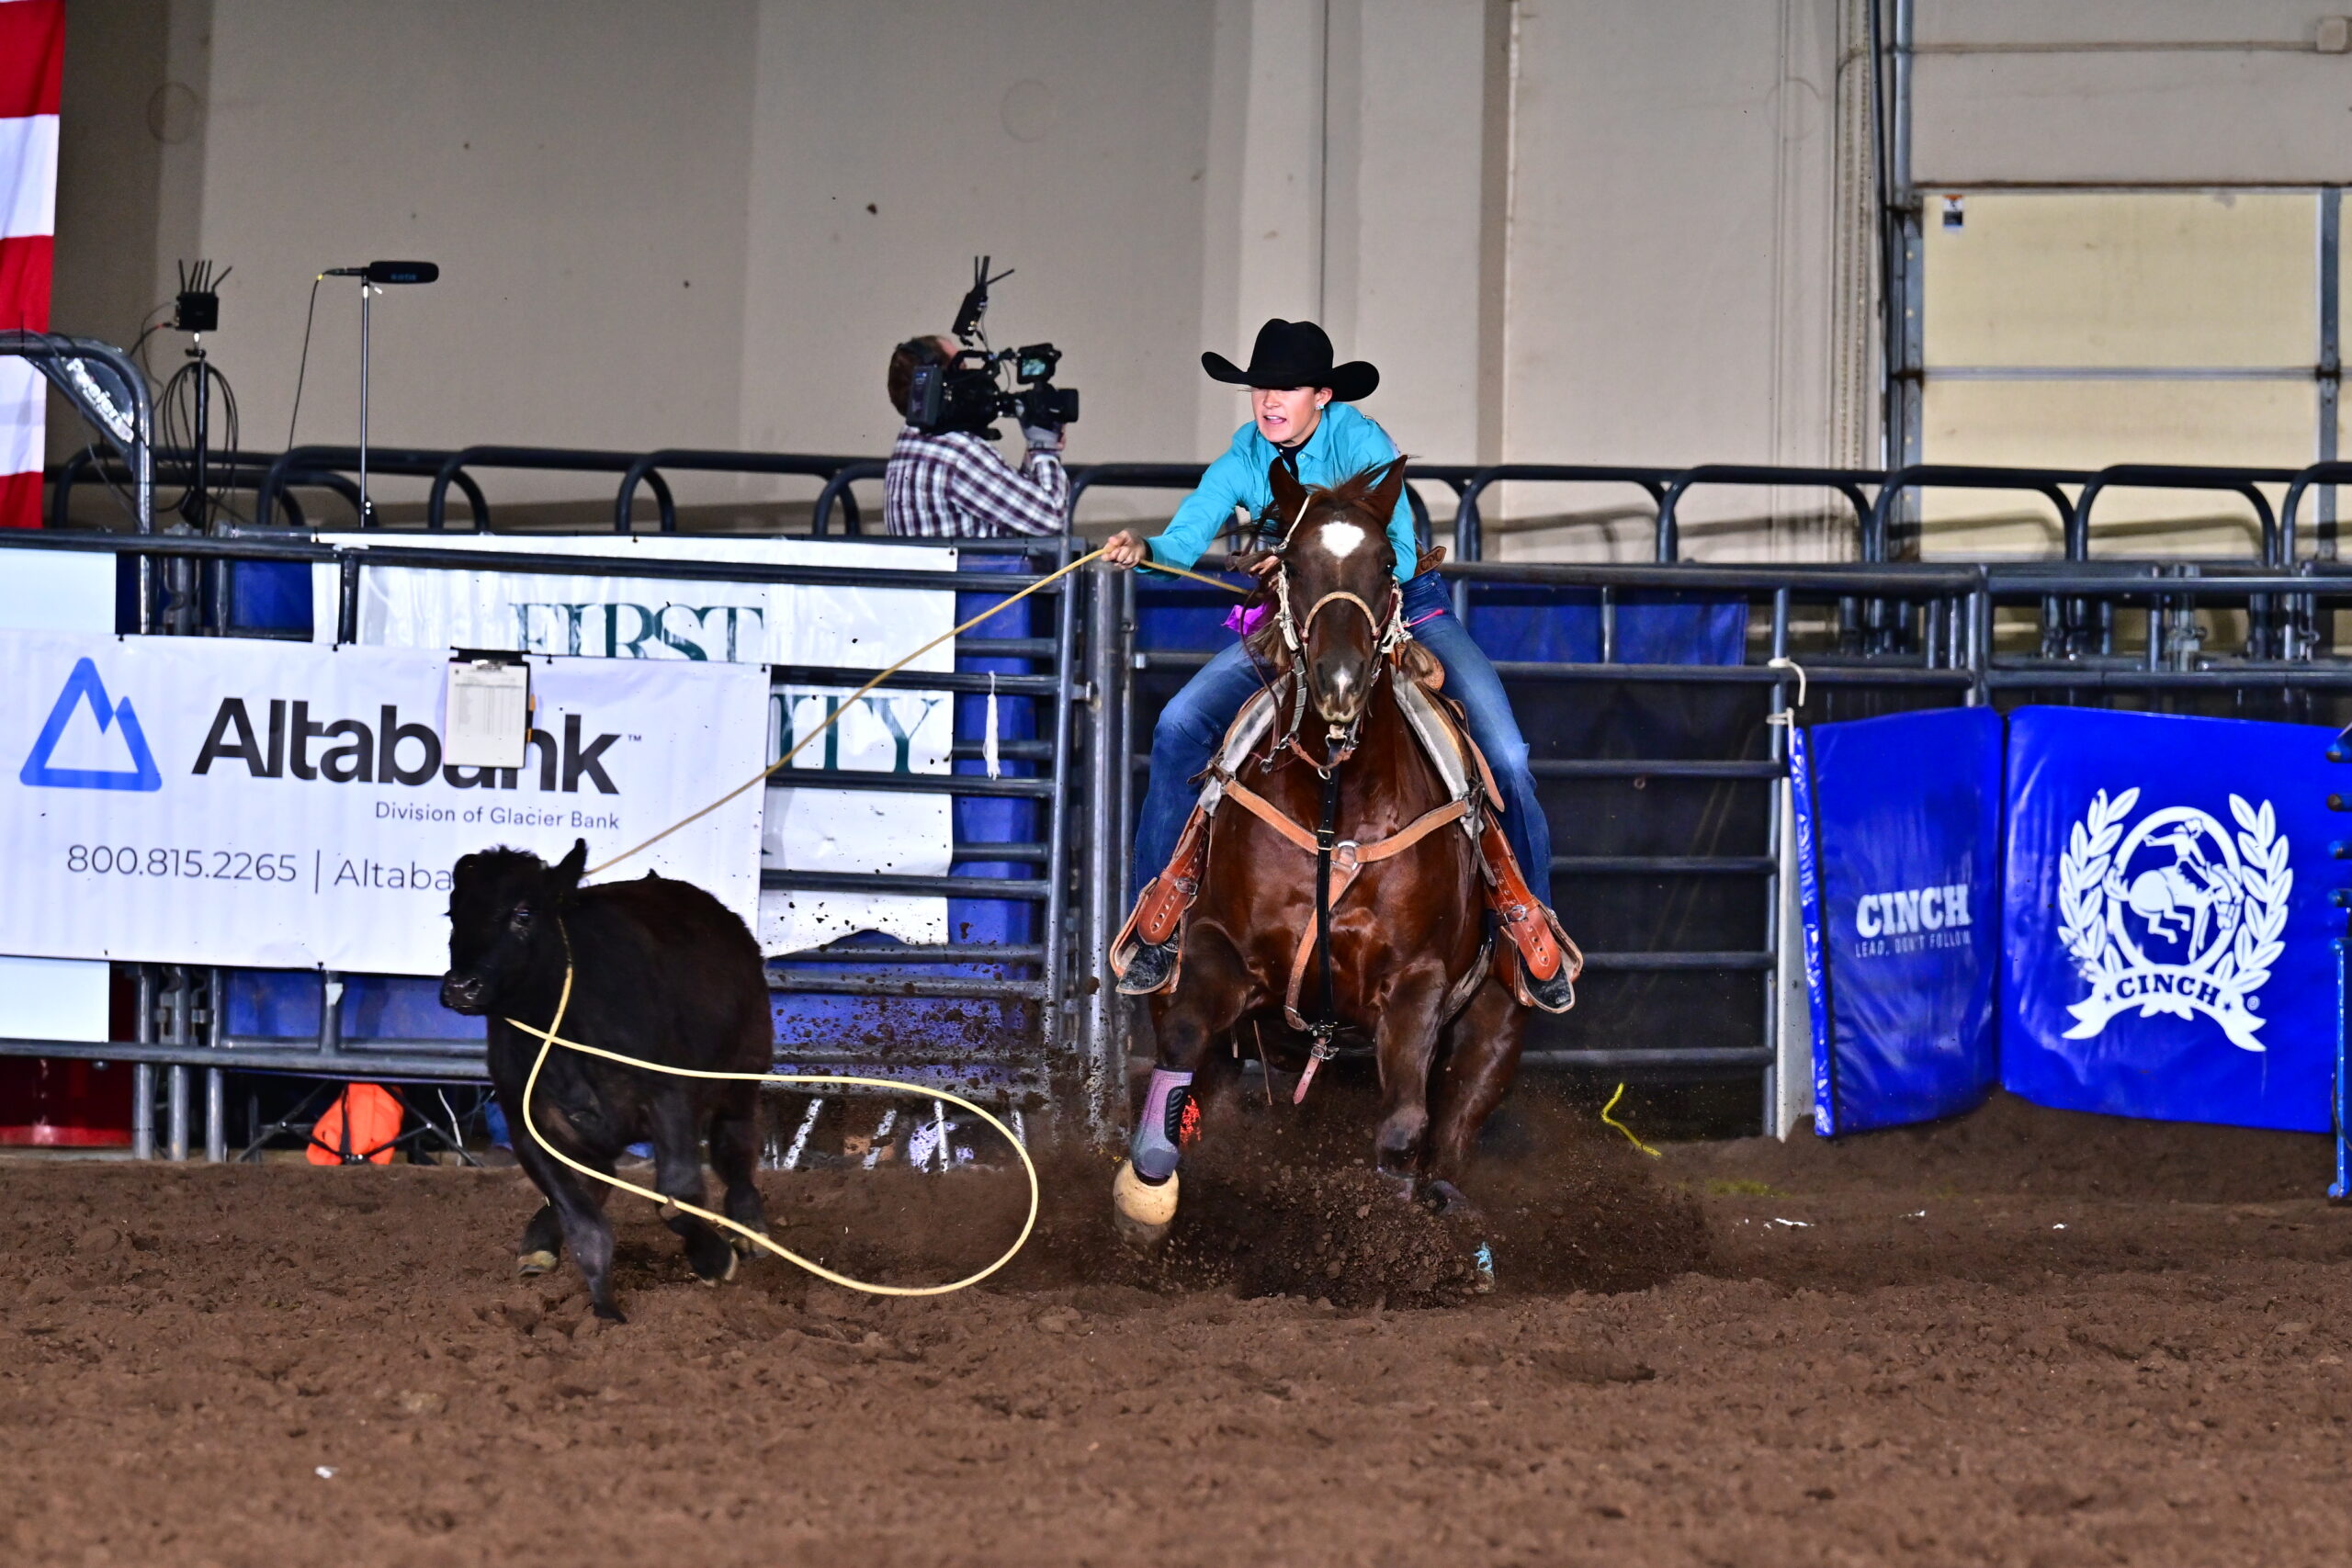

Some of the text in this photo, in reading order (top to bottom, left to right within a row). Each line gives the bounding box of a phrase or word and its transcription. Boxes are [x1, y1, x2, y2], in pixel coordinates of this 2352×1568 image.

[507, 603, 763, 662] FIRST
[375, 801, 620, 829] Division of Glacier Bank
[67, 844, 297, 882] 800.815.2265
[1856, 883, 1973, 938] CINCH
[2116, 974, 2221, 1008] CINCH
